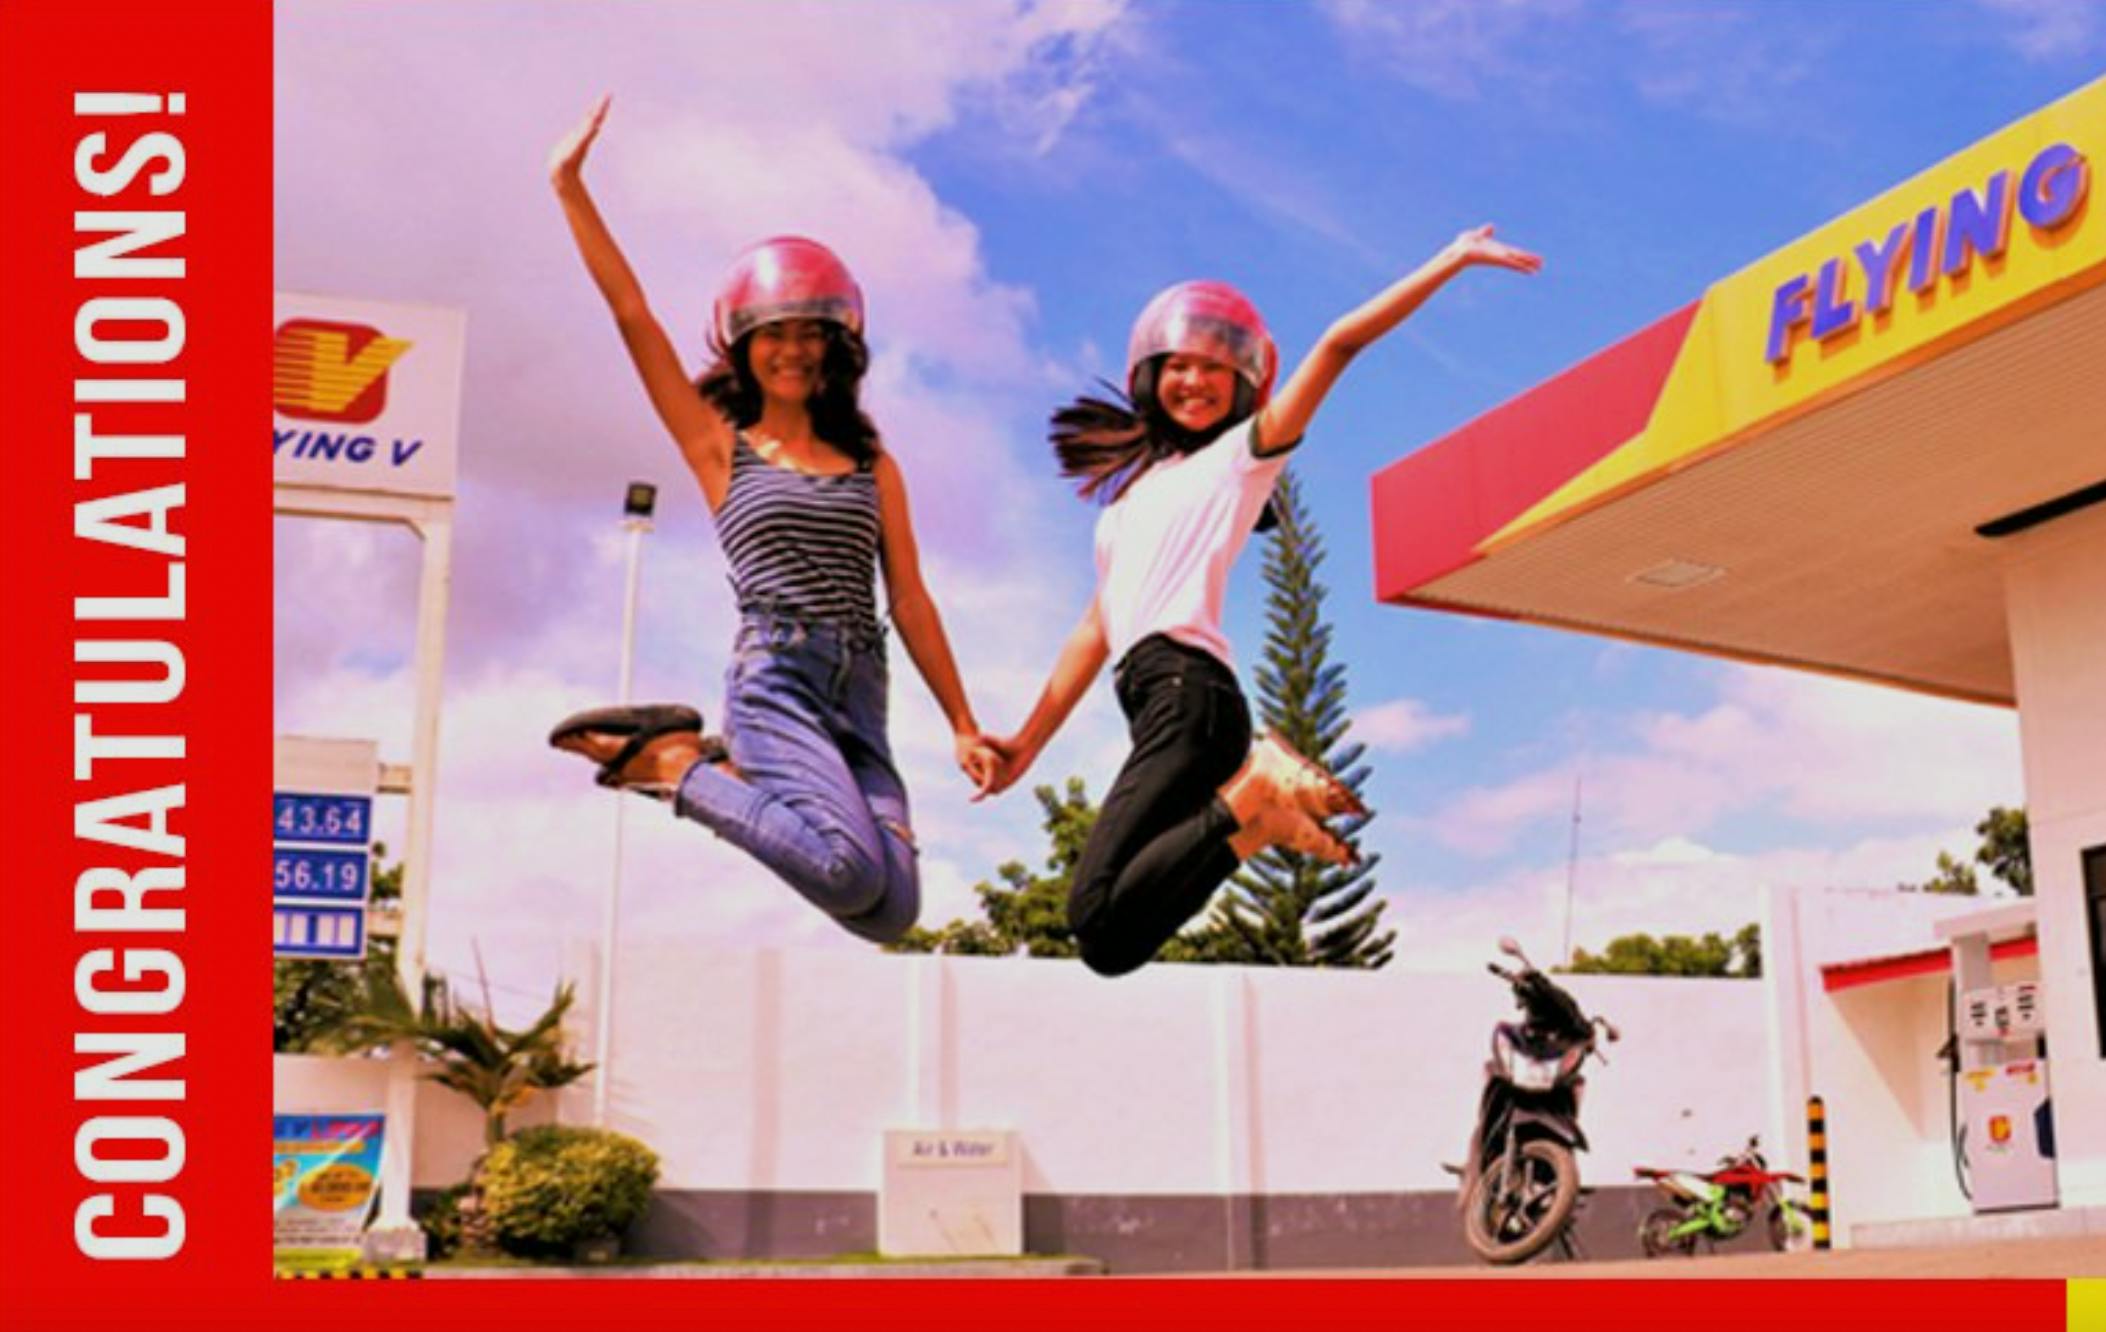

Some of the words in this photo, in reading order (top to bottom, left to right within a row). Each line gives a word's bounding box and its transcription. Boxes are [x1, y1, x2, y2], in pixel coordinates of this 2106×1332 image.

[1765, 142, 2090, 366] FLYING
[392, 439, 424, 467] V
[277, 805, 362, 835] 43.64
[274, 859, 359, 891] 56.19
